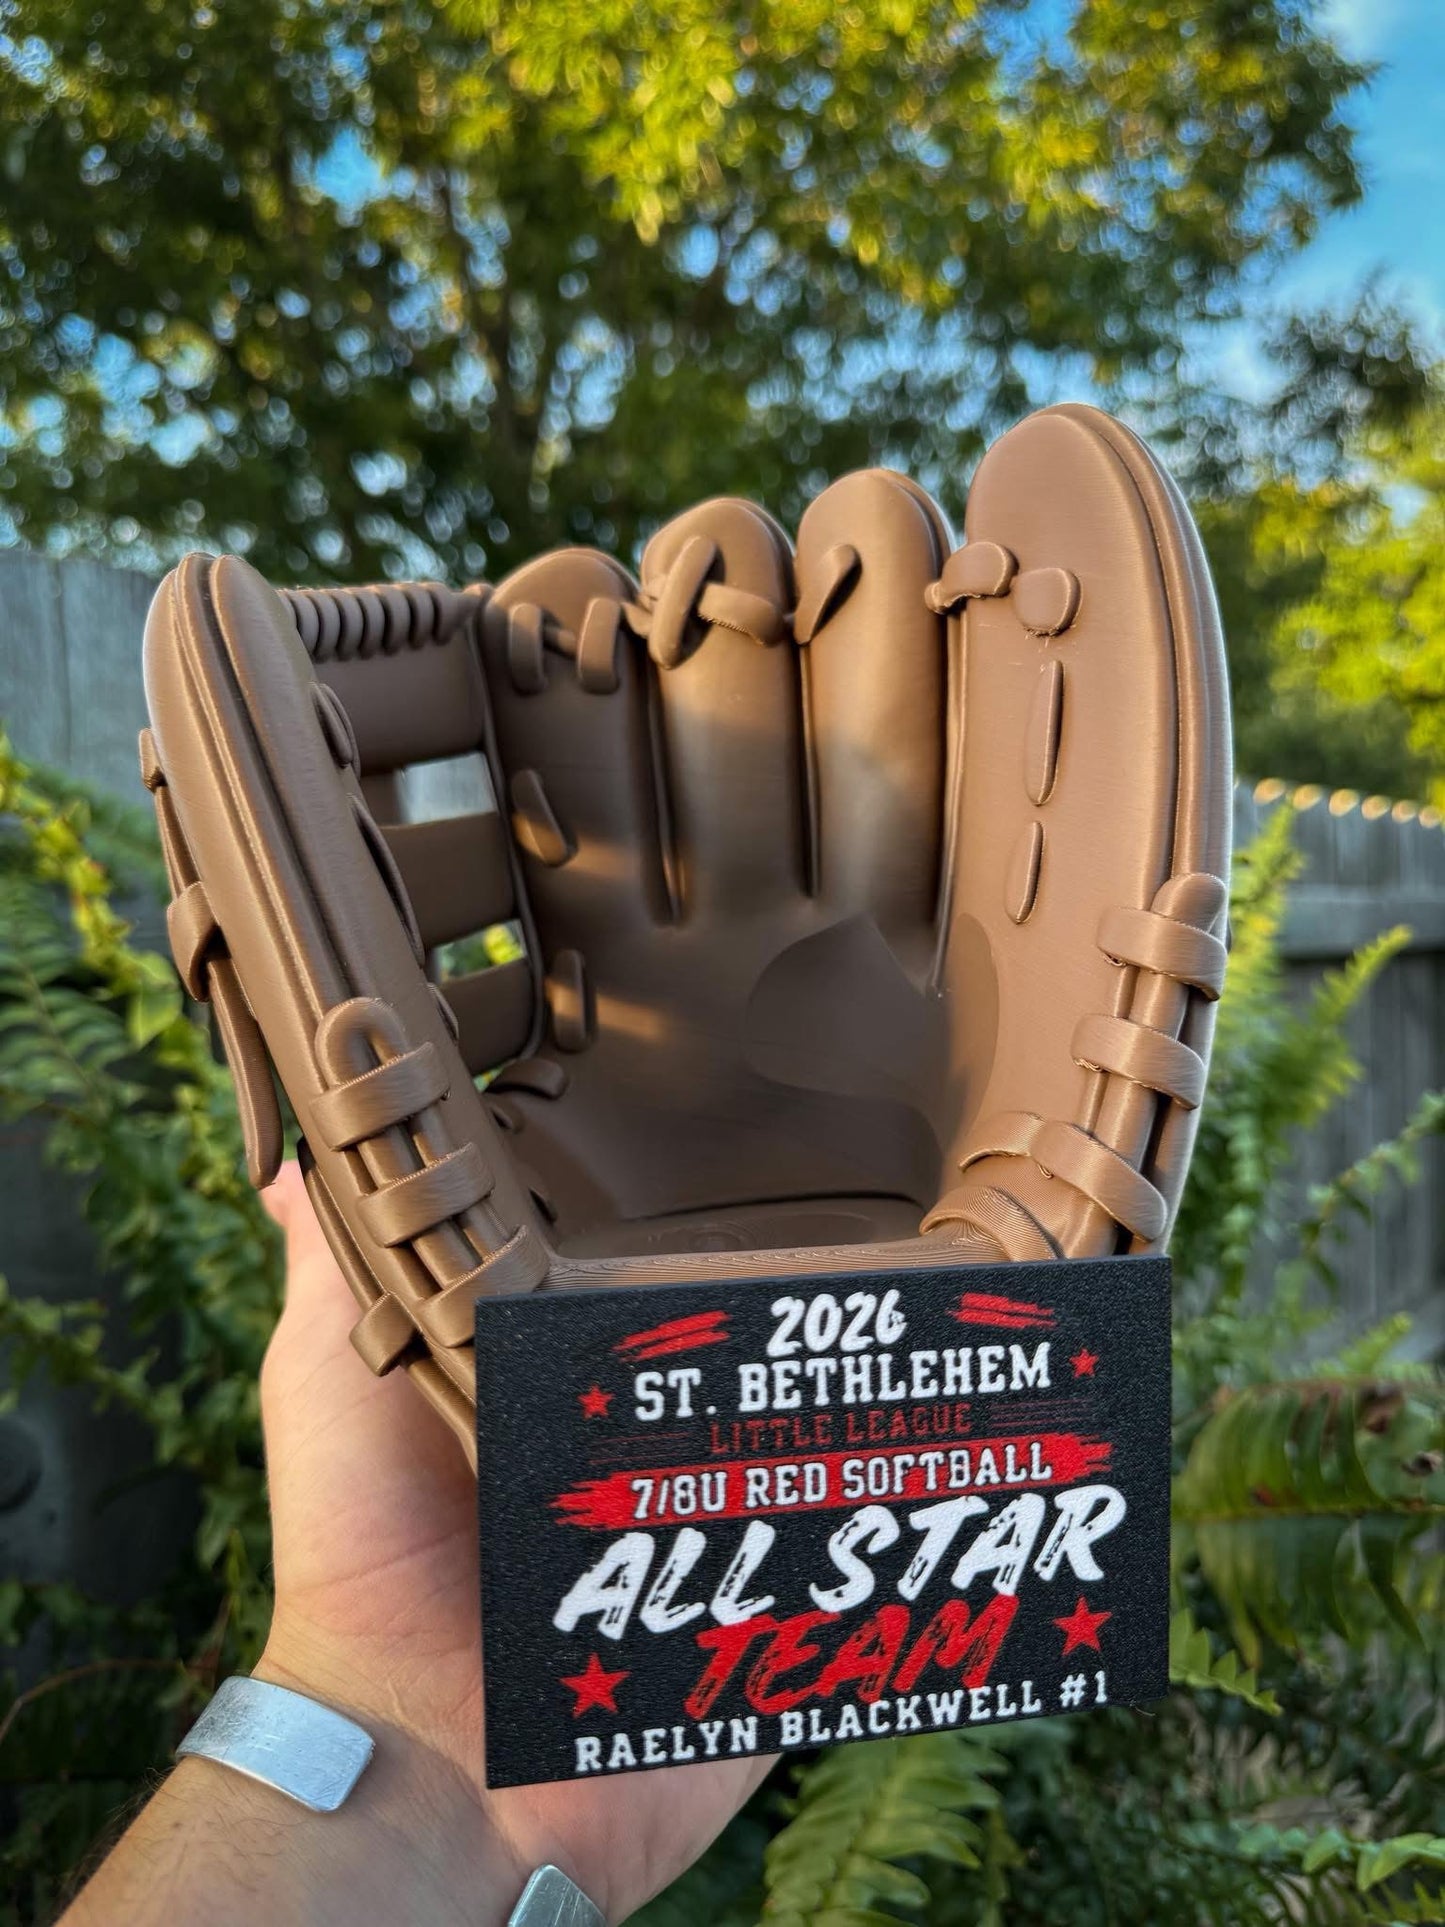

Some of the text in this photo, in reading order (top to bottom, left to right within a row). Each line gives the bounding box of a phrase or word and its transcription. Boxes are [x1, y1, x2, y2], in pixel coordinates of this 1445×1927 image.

[766, 1289, 908, 1358] 2026
[634, 1342, 1052, 1421] ST. BETHLEHEM
[710, 1402, 973, 1454] LITTLE LEAGUE
[629, 1441, 1052, 1520] 7/8U RED SOFTBALL
[552, 1484, 1127, 1640] ALL STAR
[684, 1593, 1020, 1720] TEAM
[574, 1670, 1108, 1772] RAELYN BLACKWELL #1
